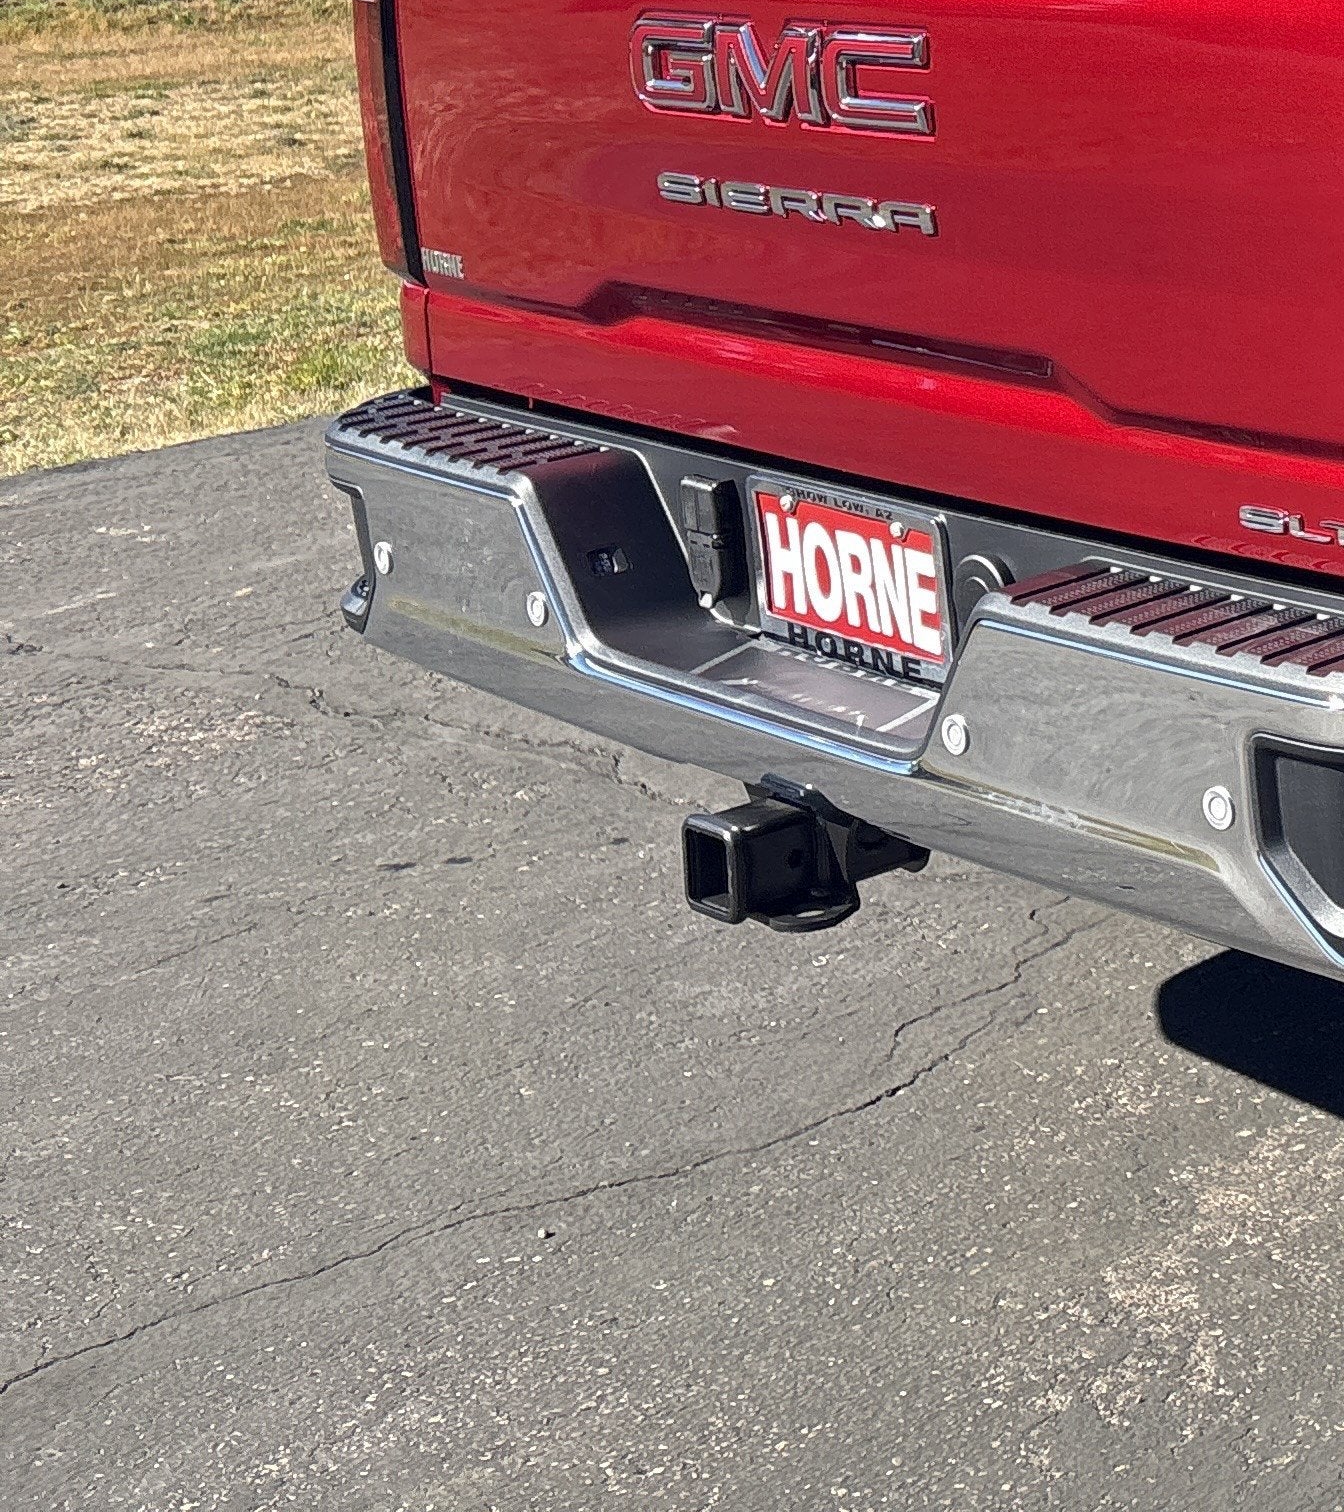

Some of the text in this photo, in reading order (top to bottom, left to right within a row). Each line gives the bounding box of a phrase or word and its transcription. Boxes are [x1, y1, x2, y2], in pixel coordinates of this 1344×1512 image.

[629, 10, 937, 136] GMC
[656, 171, 937, 236] SIERRA
[764, 511, 943, 657] HORNE
[787, 623, 922, 680] HORNE
